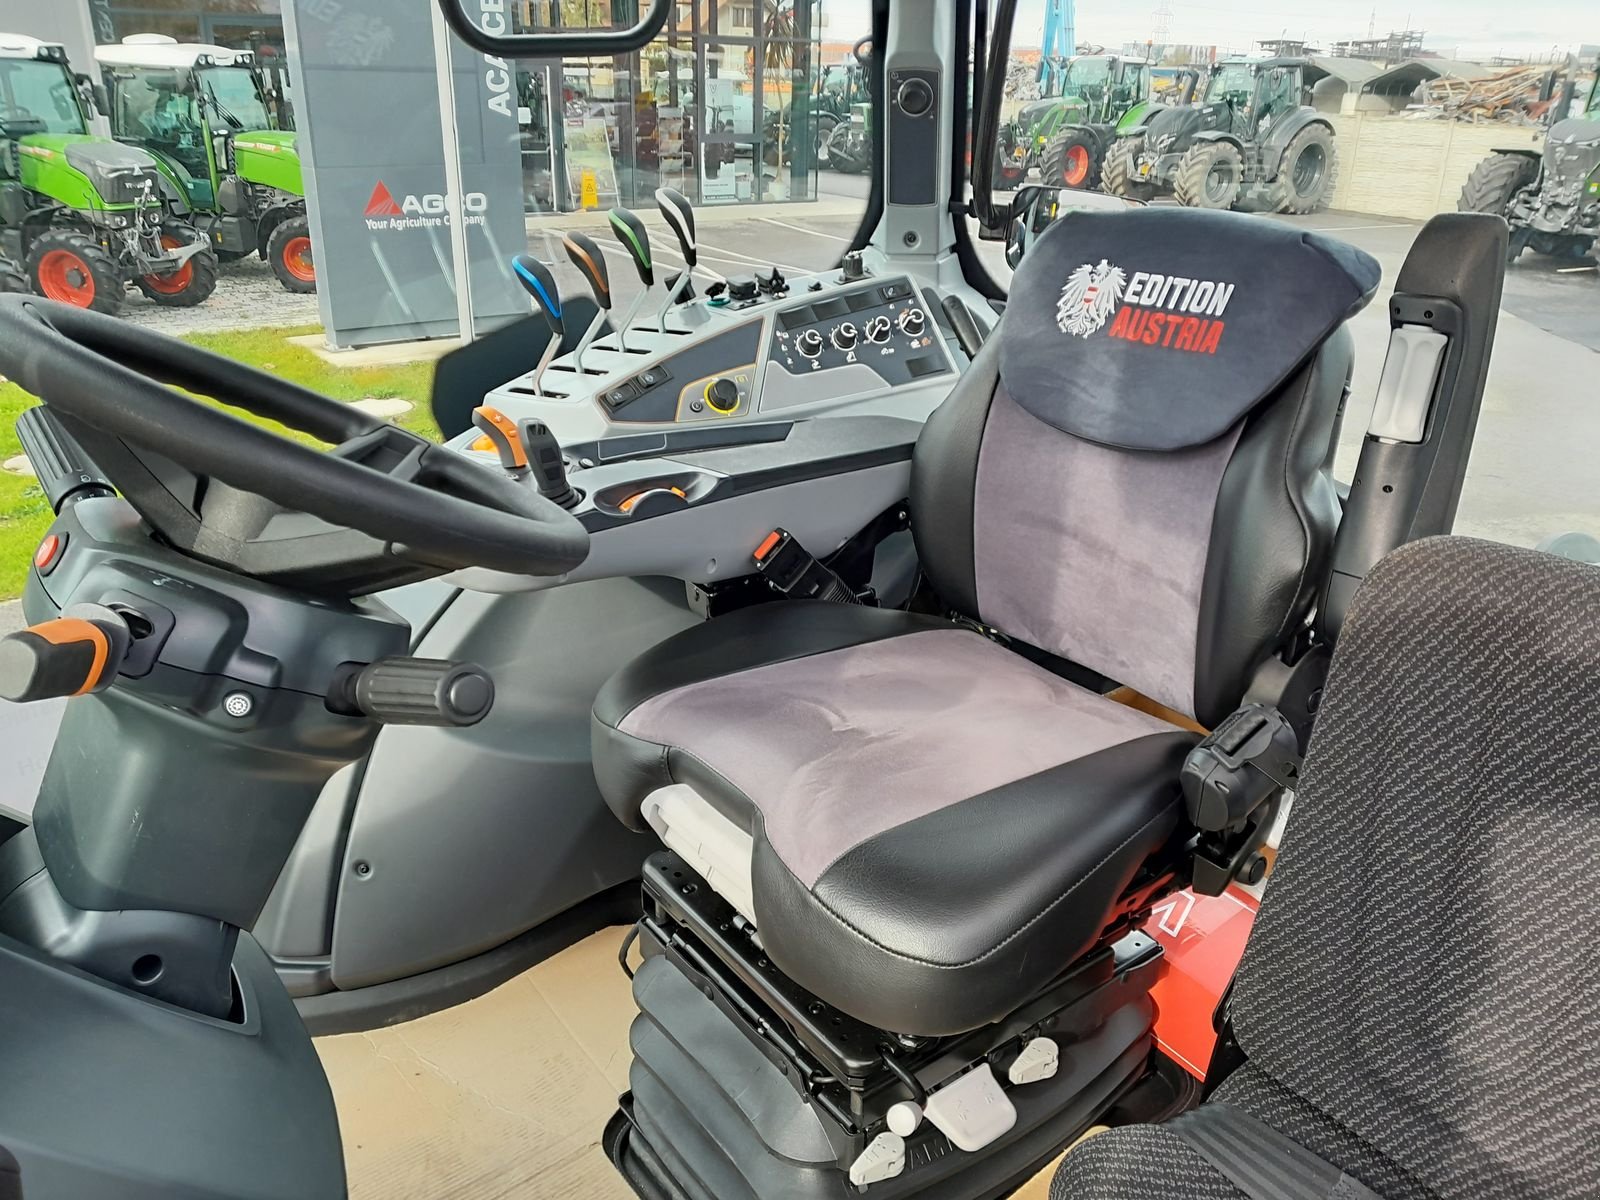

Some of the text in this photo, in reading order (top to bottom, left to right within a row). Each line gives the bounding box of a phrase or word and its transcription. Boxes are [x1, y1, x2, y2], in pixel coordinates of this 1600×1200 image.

[365, 215, 485, 231] Your Agriculture Cpany
[1123, 271, 1235, 316] EDITION
[1108, 306, 1225, 354] AUSTRIA
